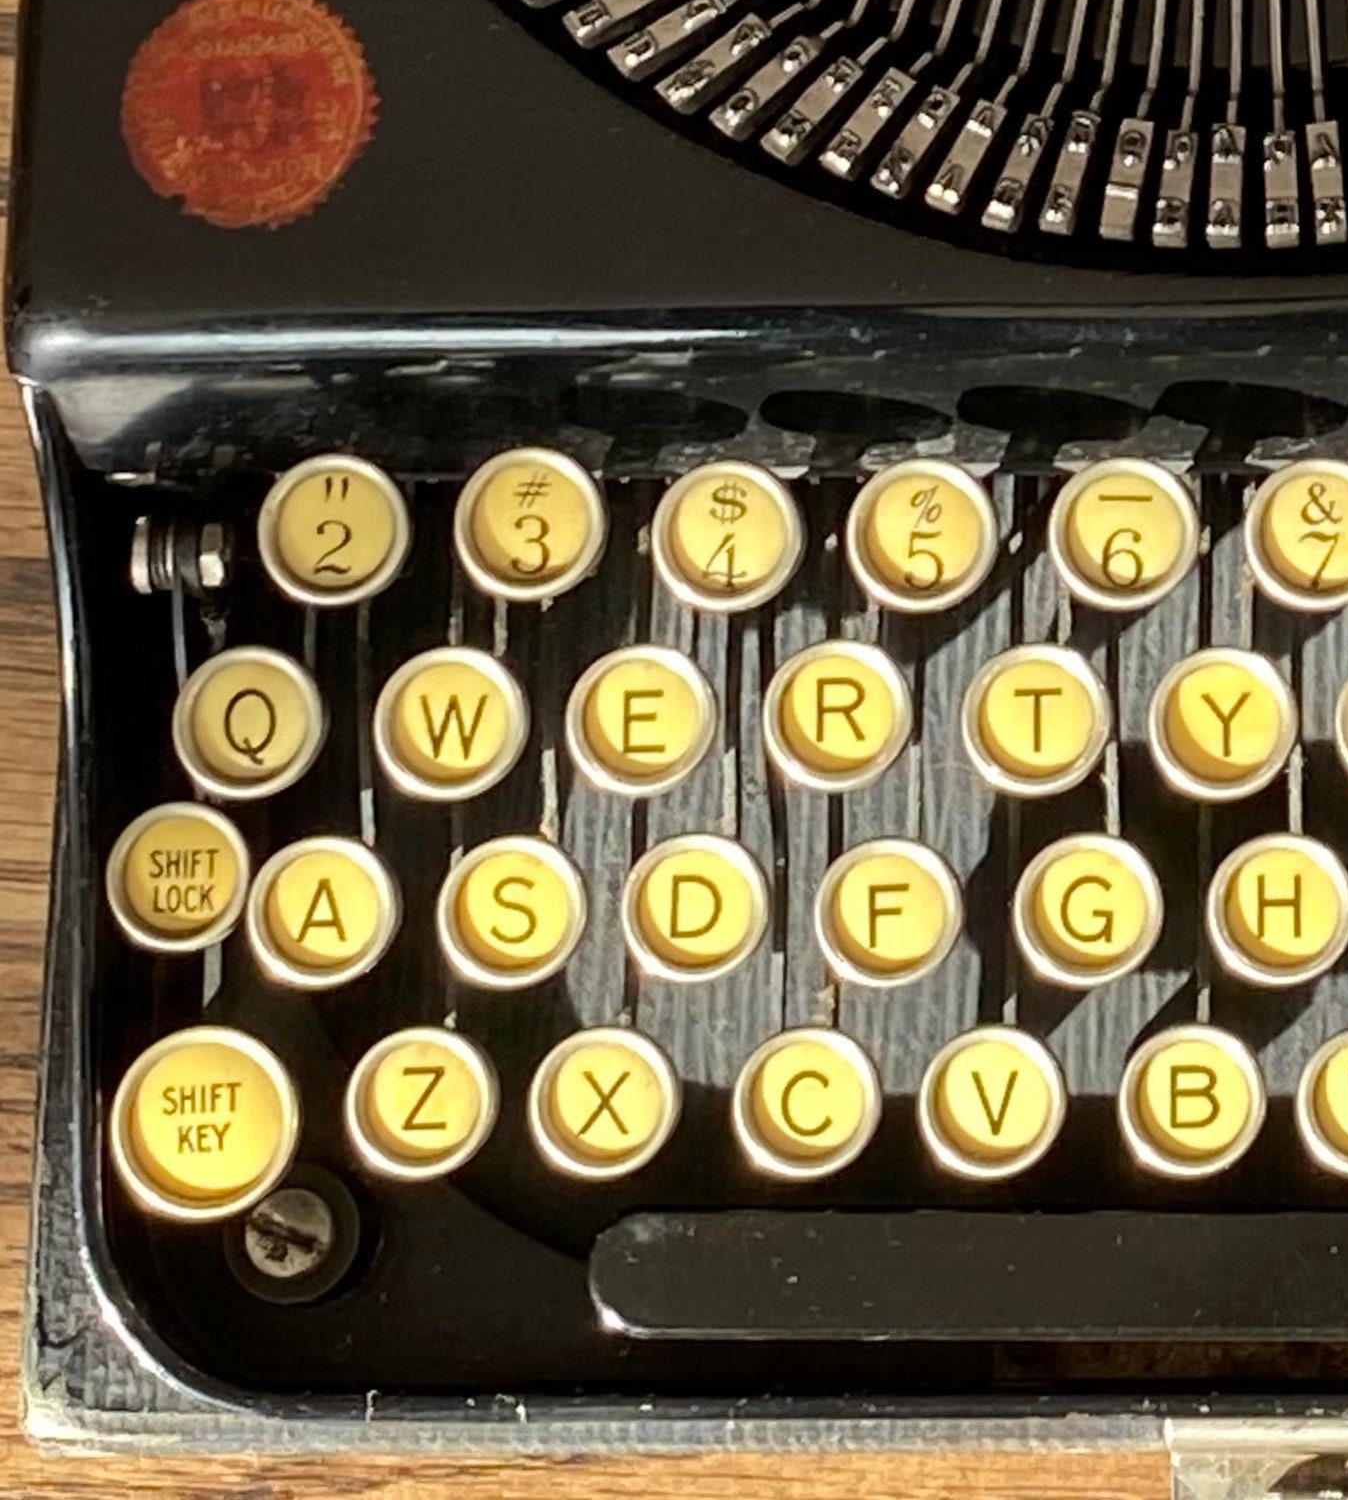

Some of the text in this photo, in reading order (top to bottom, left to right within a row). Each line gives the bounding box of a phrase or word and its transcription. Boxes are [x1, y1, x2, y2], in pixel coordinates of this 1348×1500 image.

[513, 474, 551, 509] #
[709, 481, 747, 526] $
[910, 484, 943, 529] %
[1300, 482, 1341, 526] &
[314, 520, 352, 576] 2
[511, 515, 551, 575] 3
[702, 533, 748, 588] 4
[905, 531, 945, 590] 5
[1102, 528, 1143, 588] 6
[1300, 531, 1340, 589] 7
[223, 688, 277, 764] Q
[419, 693, 489, 761] W
[621, 688, 666, 755] E
[815, 676, 866, 743] R
[1013, 687, 1063, 754] T
[1201, 691, 1252, 758] Y
[149, 848, 219, 880] SHIFT
[152, 884, 215, 914] LOCK
[295, 877, 348, 944] A
[489, 875, 538, 944] S
[669, 874, 723, 939] D
[867, 883, 910, 949] F
[1059, 875, 1114, 944] G
[1255, 873, 1302, 939] H
[161, 1081, 242, 1117] SHIFT
[402, 1066, 447, 1132] Z
[578, 1070, 632, 1136] X
[781, 1070, 833, 1137] C
[971, 1070, 1019, 1136] V
[1169, 1064, 1221, 1129] B
[176, 1122, 232, 1154] KEY
